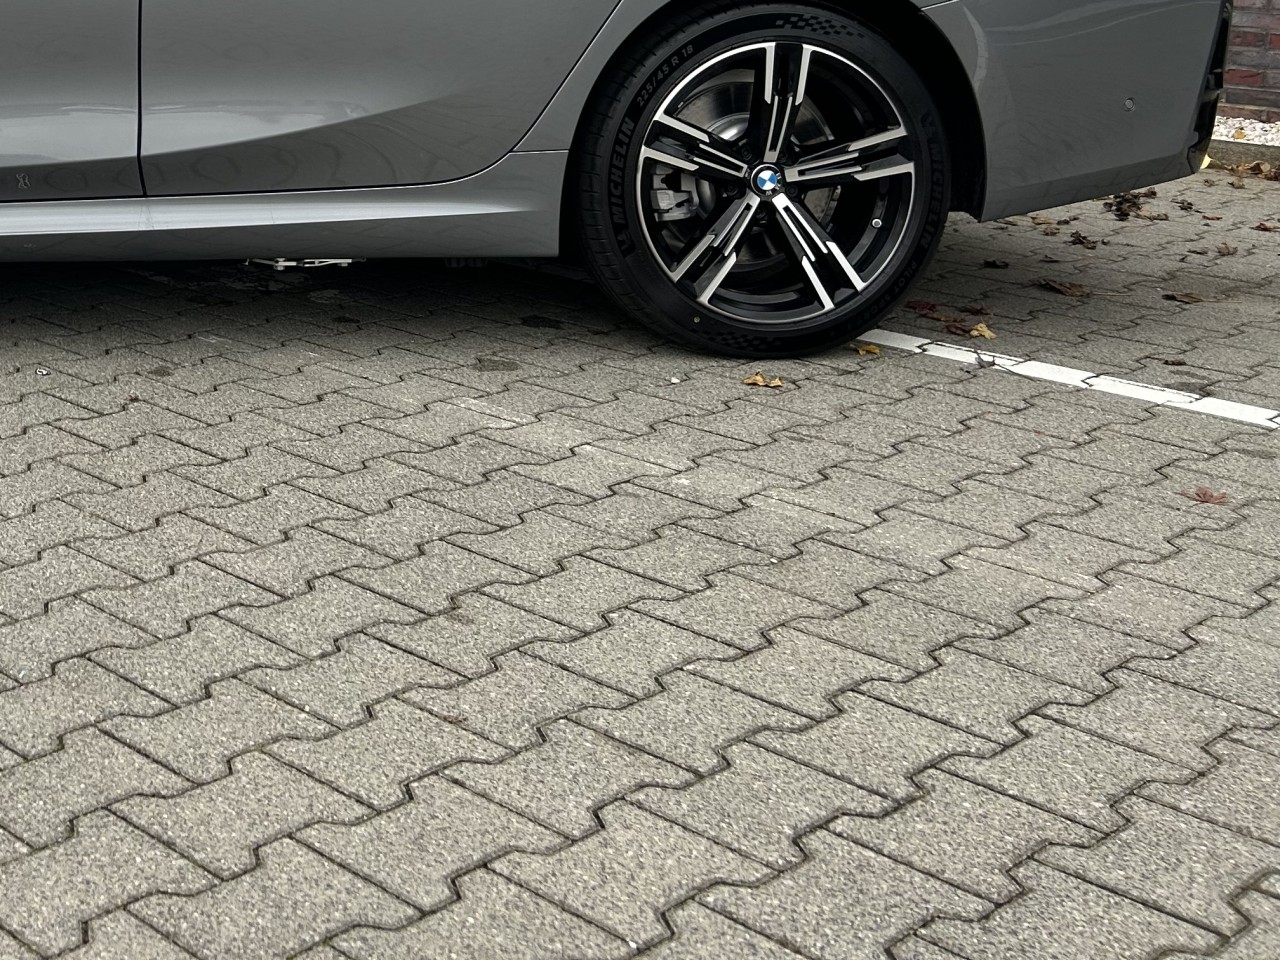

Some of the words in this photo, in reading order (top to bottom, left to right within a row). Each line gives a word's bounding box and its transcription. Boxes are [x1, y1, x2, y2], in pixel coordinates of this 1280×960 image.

[609, 117, 635, 225] MICHELIN
[636, 64, 670, 107] 225/45
[671, 55, 680, 67] R
[681, 44, 694, 58] 18
